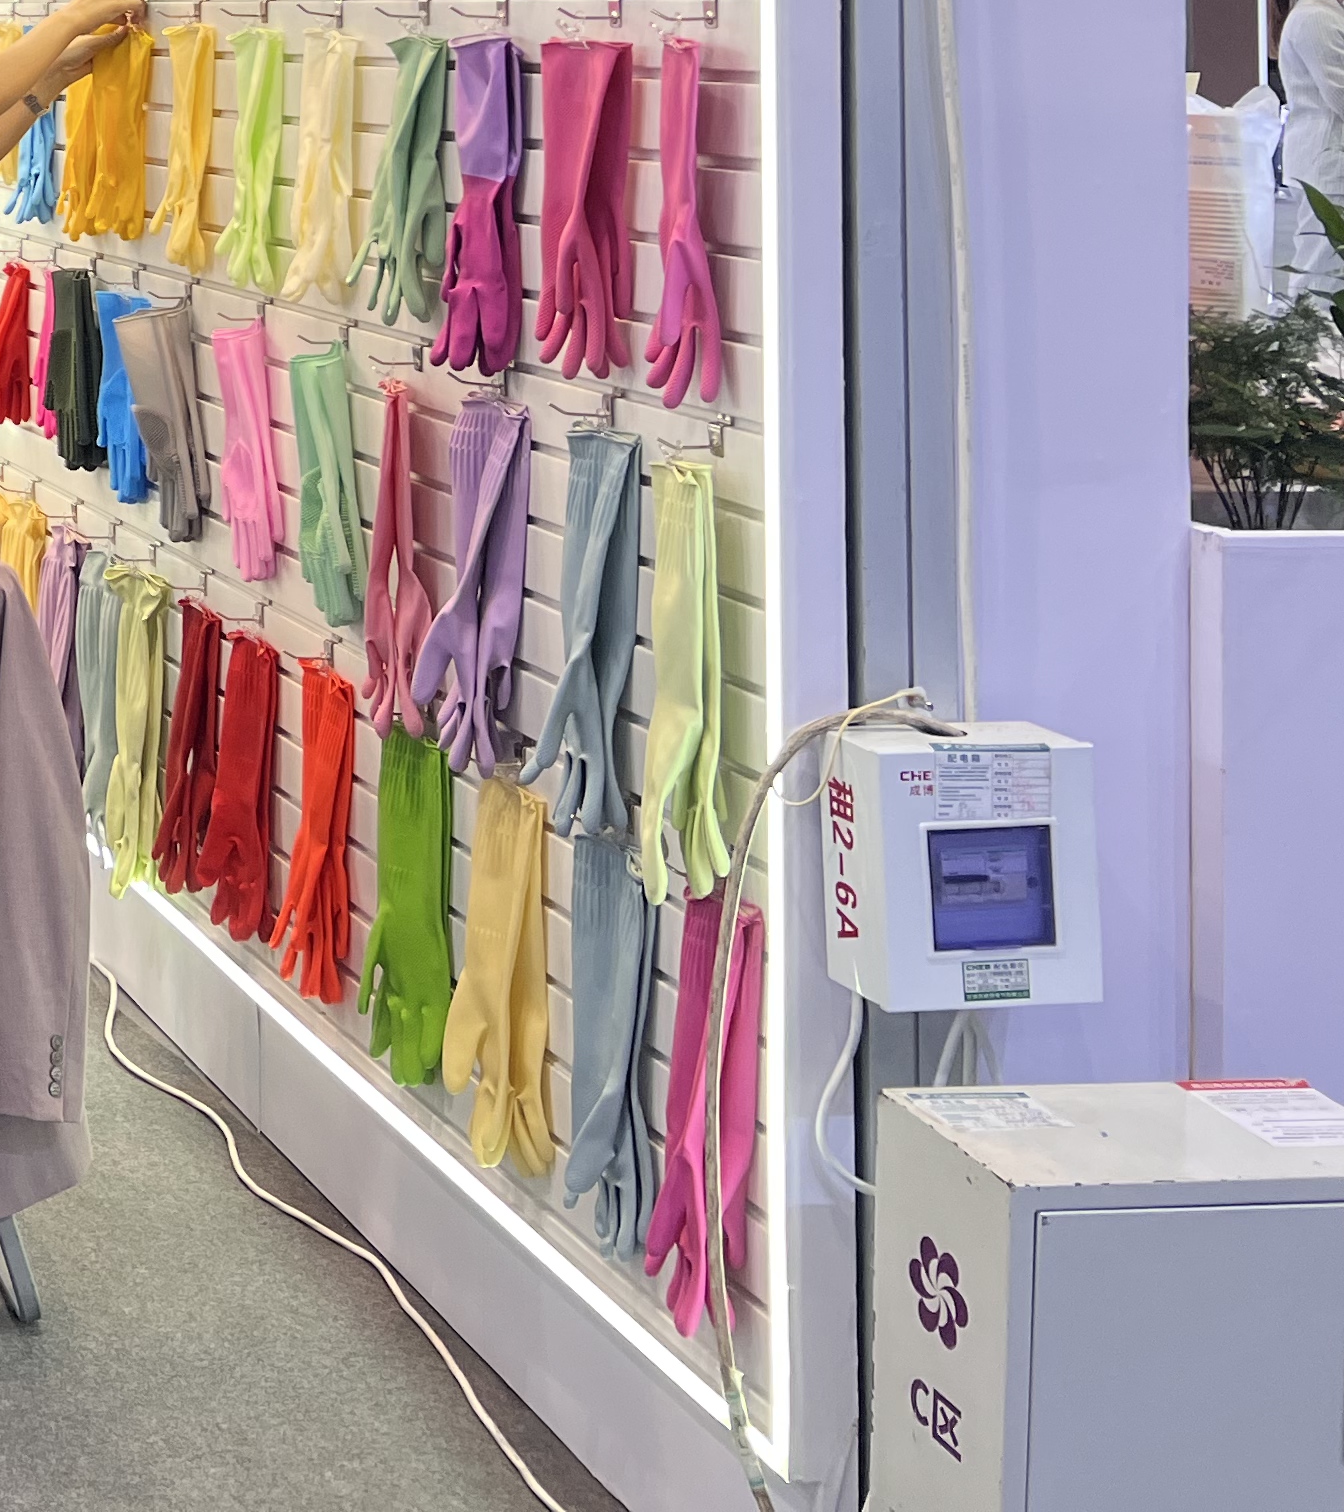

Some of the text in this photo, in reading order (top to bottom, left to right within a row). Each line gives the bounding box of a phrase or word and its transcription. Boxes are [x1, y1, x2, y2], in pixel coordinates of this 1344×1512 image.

[899, 770, 933, 782] CHE
[827, 776, 859, 939] 租2-6A
[910, 1378, 962, 1462] C区
